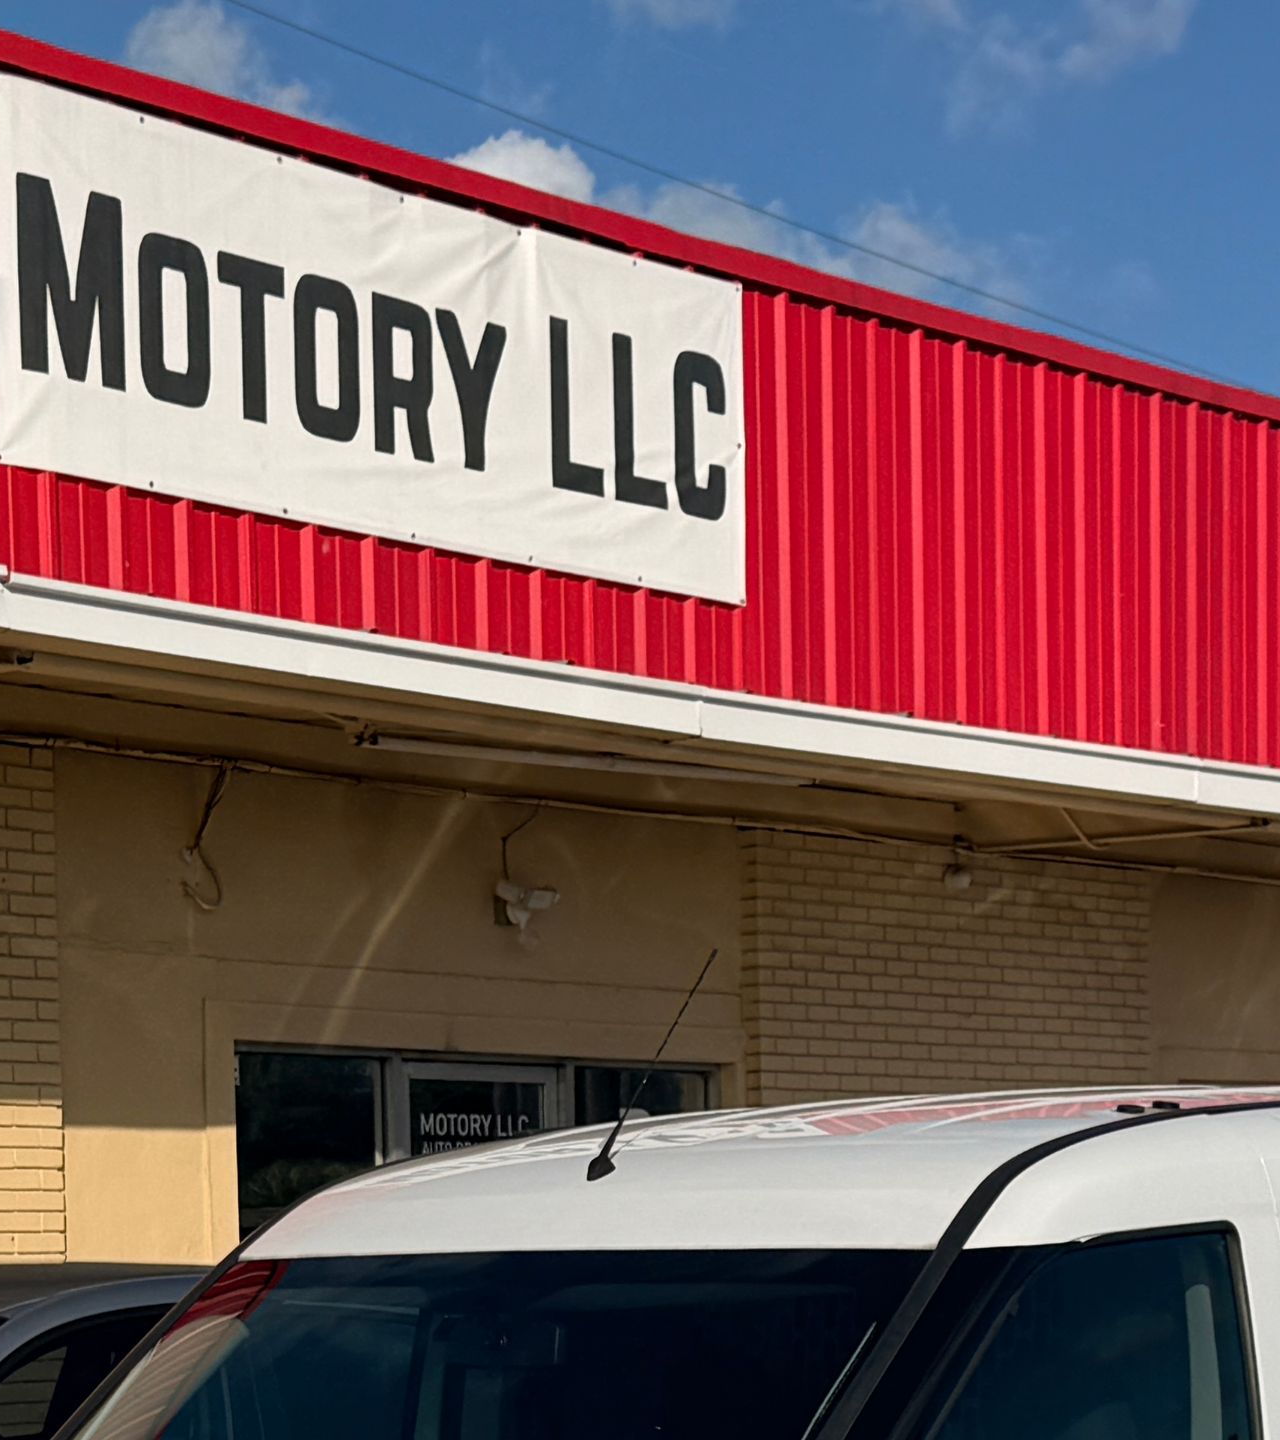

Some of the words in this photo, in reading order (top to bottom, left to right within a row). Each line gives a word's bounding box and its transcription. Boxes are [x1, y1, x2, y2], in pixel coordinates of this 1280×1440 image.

[16, 171, 507, 472] MOTORY
[549, 314, 726, 521] LLC
[420, 1112, 493, 1137] MOTORY
